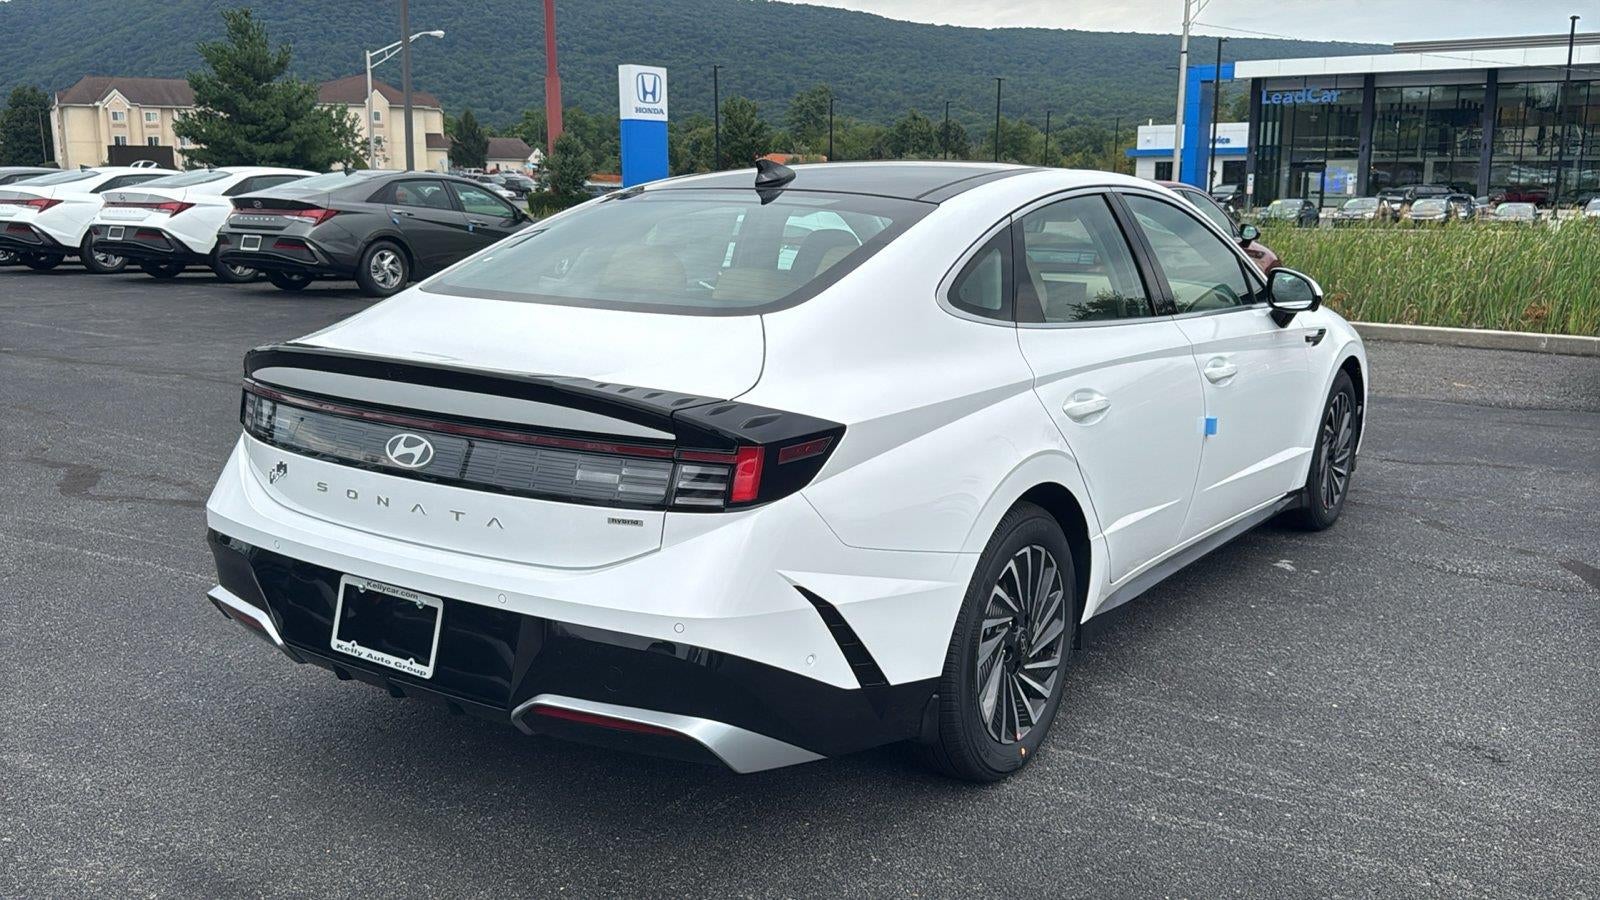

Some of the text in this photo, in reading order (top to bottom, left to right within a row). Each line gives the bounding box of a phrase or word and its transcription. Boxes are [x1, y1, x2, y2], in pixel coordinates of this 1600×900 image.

[1261, 84, 1340, 105] LeadCar
[634, 106, 665, 115] HONDA
[1210, 136, 1231, 144] vice
[316, 480, 505, 530] SONATA
[610, 517, 640, 526] hybrid
[366, 580, 419, 600] Kellycar.com
[335, 643, 427, 677] Kelly Auto Group
